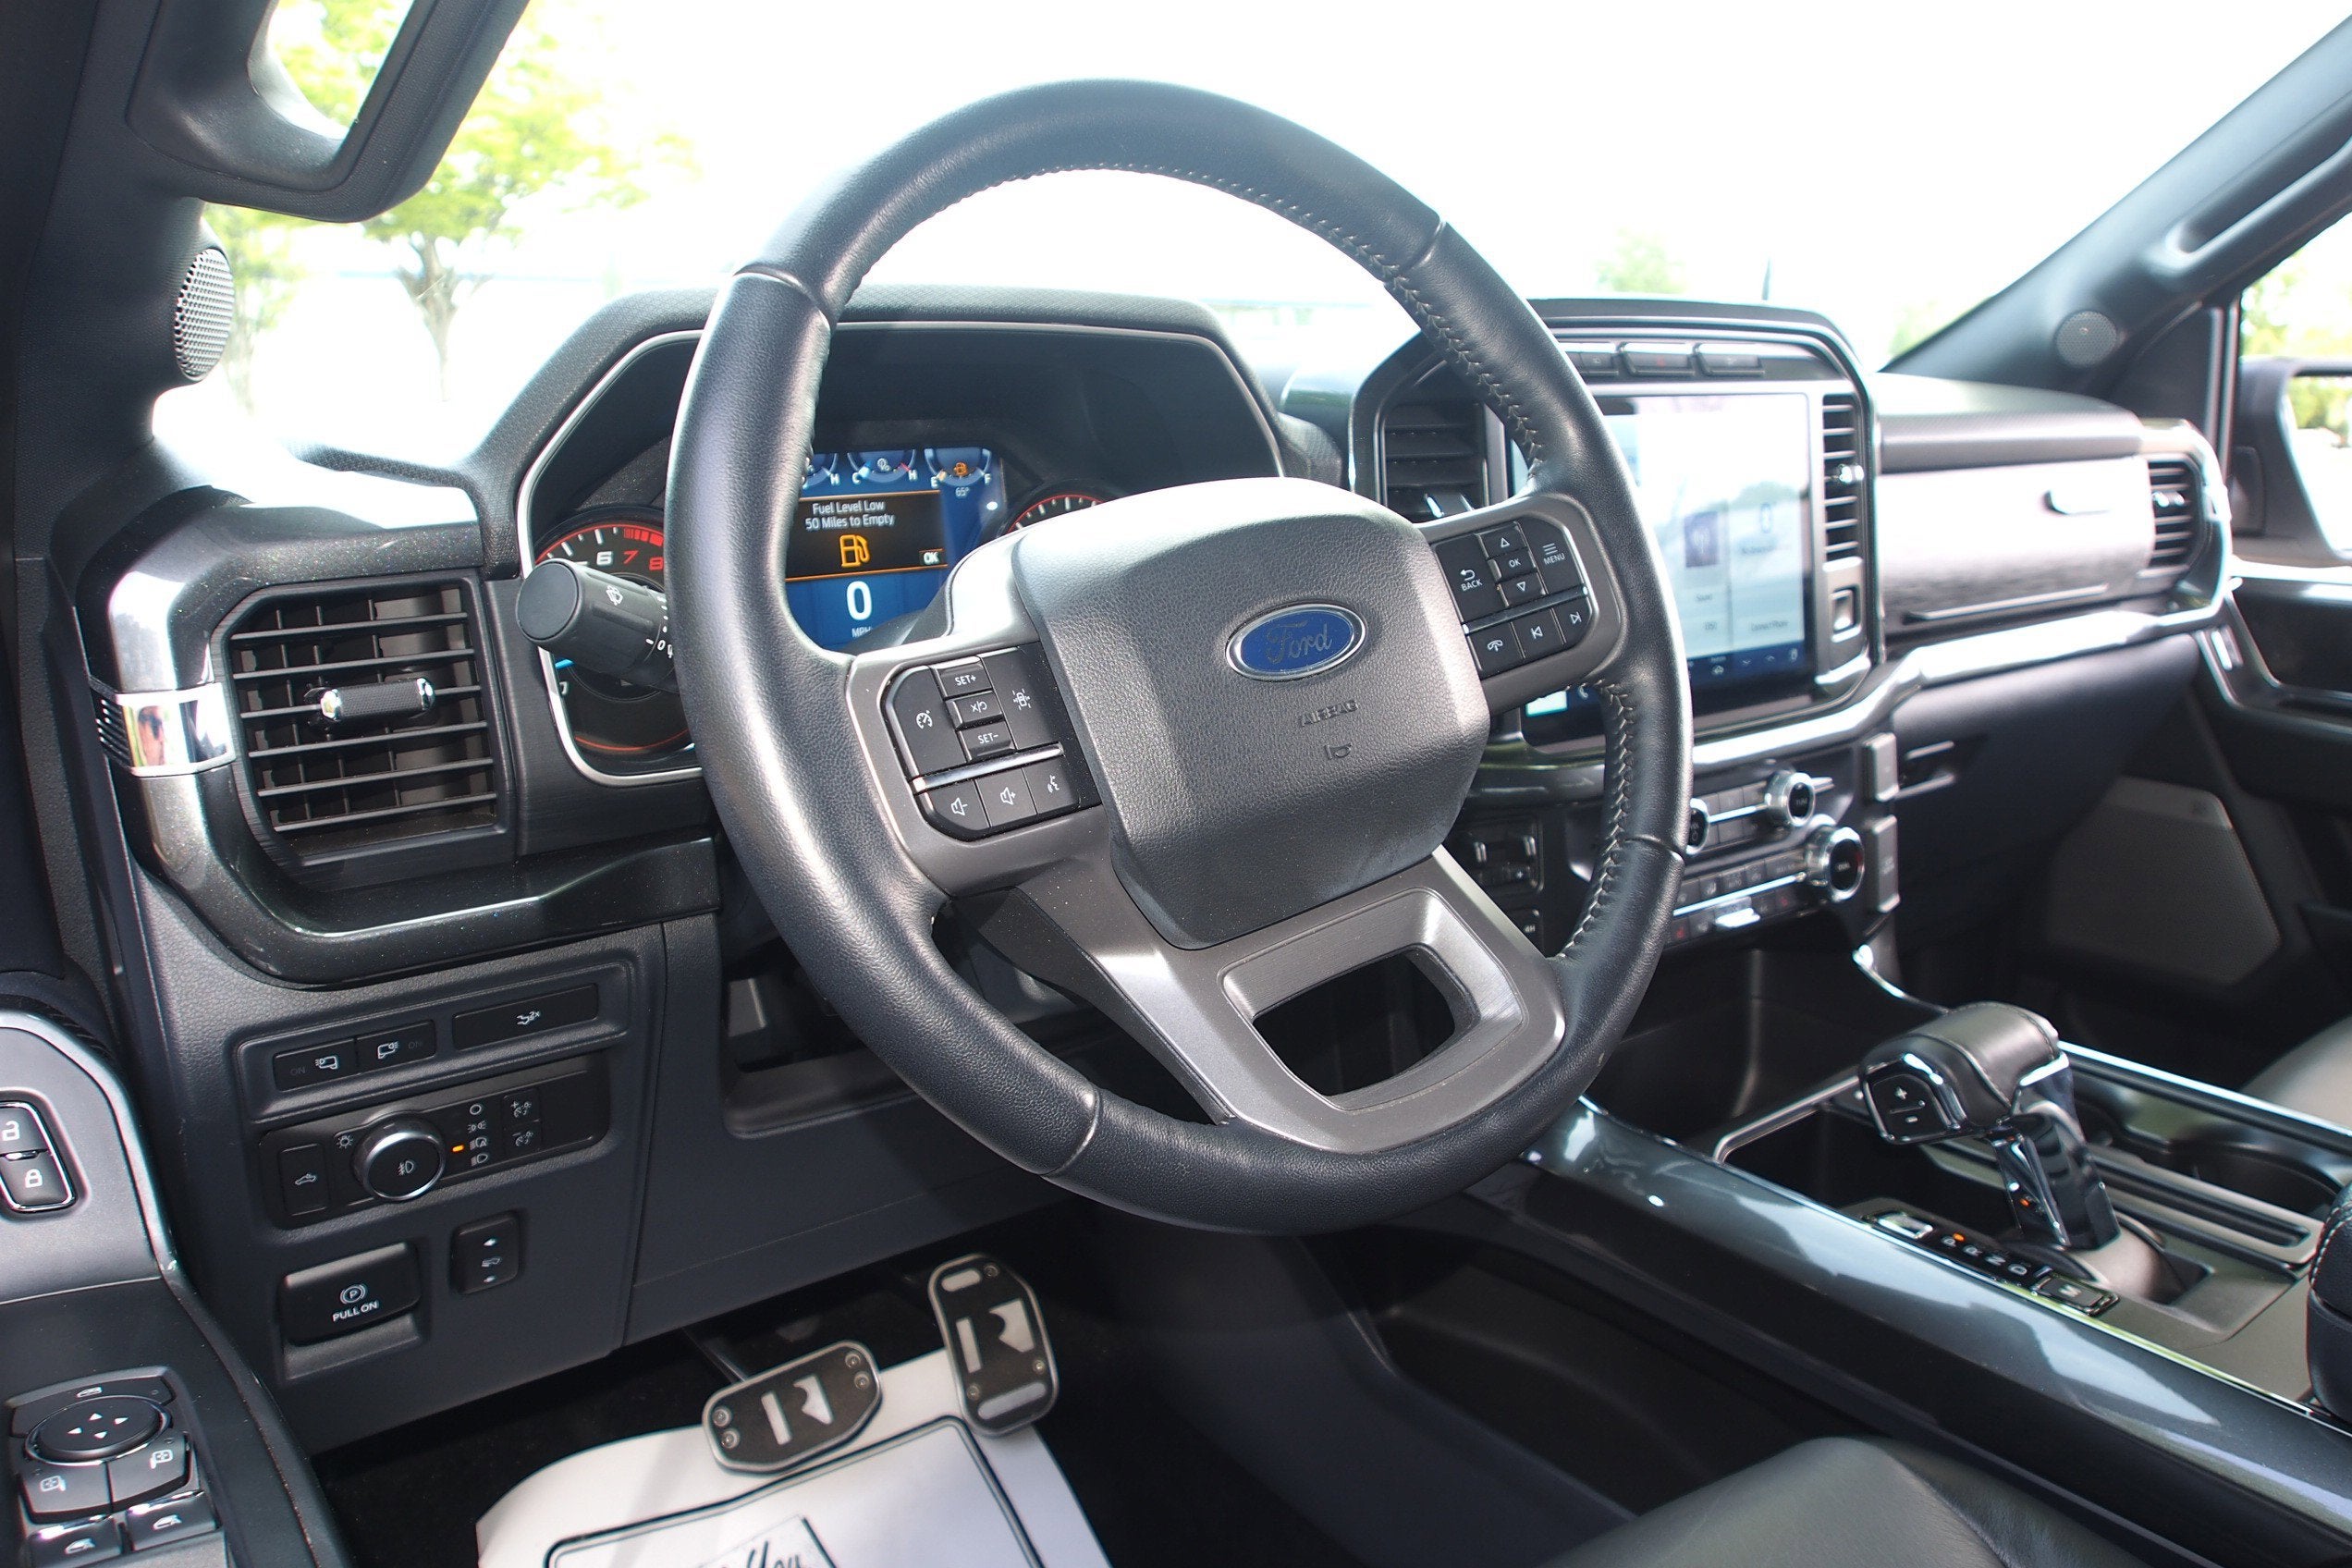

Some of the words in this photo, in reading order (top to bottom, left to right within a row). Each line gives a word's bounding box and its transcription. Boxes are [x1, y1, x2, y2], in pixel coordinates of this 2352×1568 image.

[812, 502, 834, 515] Fuel
[836, 500, 862, 513] Level
[864, 499, 886, 511] Low
[804, 517, 821, 530] 50
[822, 516, 848, 529] Miles
[849, 516, 861, 527] to
[863, 512, 895, 528] Empty
[596, 551, 613, 565] 6
[623, 550, 639, 564] 7
[649, 557, 664, 570] 8
[924, 552, 938, 564] OK
[1509, 557, 1522, 568] OK
[1543, 553, 1565, 565] MENU
[1461, 579, 1483, 592] BACK
[847, 581, 872, 620] 0
[1266, 619, 1333, 665] Ford
[1299, 700, 1359, 727] AIRBAG
[1943, 1236, 1956, 1247] P
[1965, 1245, 1982, 1256] R
[1987, 1255, 2006, 1266] N
[2009, 1264, 2027, 1276] D
[2060, 1285, 2082, 1297] M
[332, 1306, 361, 1322] PULL
[360, 1299, 380, 1313] ON
